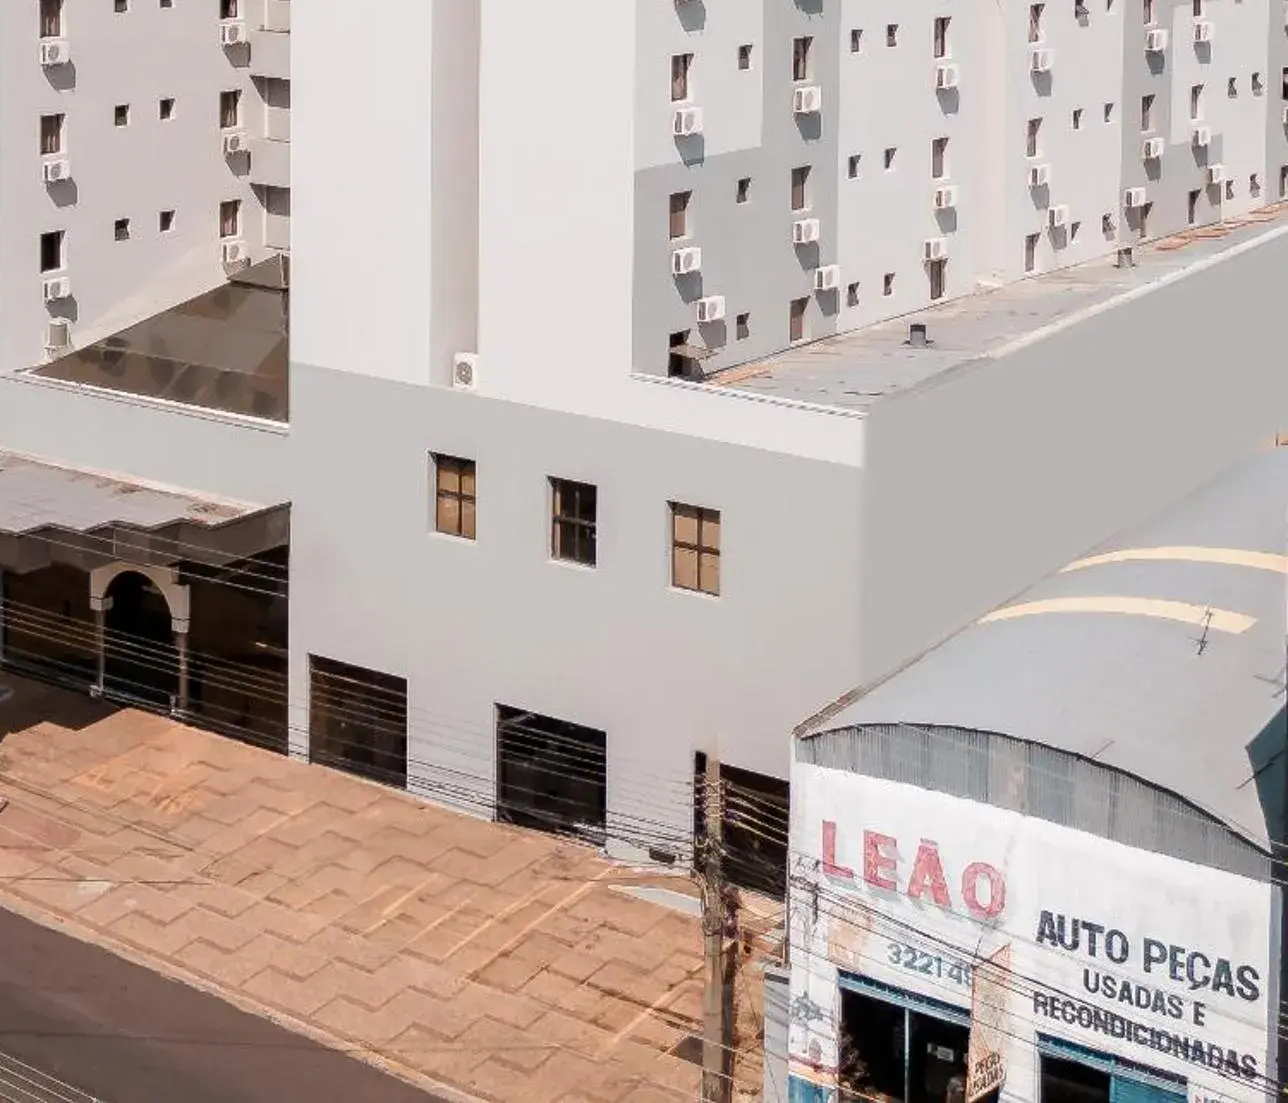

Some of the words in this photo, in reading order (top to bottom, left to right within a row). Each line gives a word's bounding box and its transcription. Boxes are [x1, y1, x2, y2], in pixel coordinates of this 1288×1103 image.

[822, 819, 1006, 919] LEÃO
[1035, 910, 1130, 965] AUTO
[1143, 937, 1260, 1002] PEÇAS
[1083, 968, 1184, 1020] USADAS
[1193, 1000, 1207, 1027] E
[1032, 991, 1259, 1079] RECONDICIONADAS
